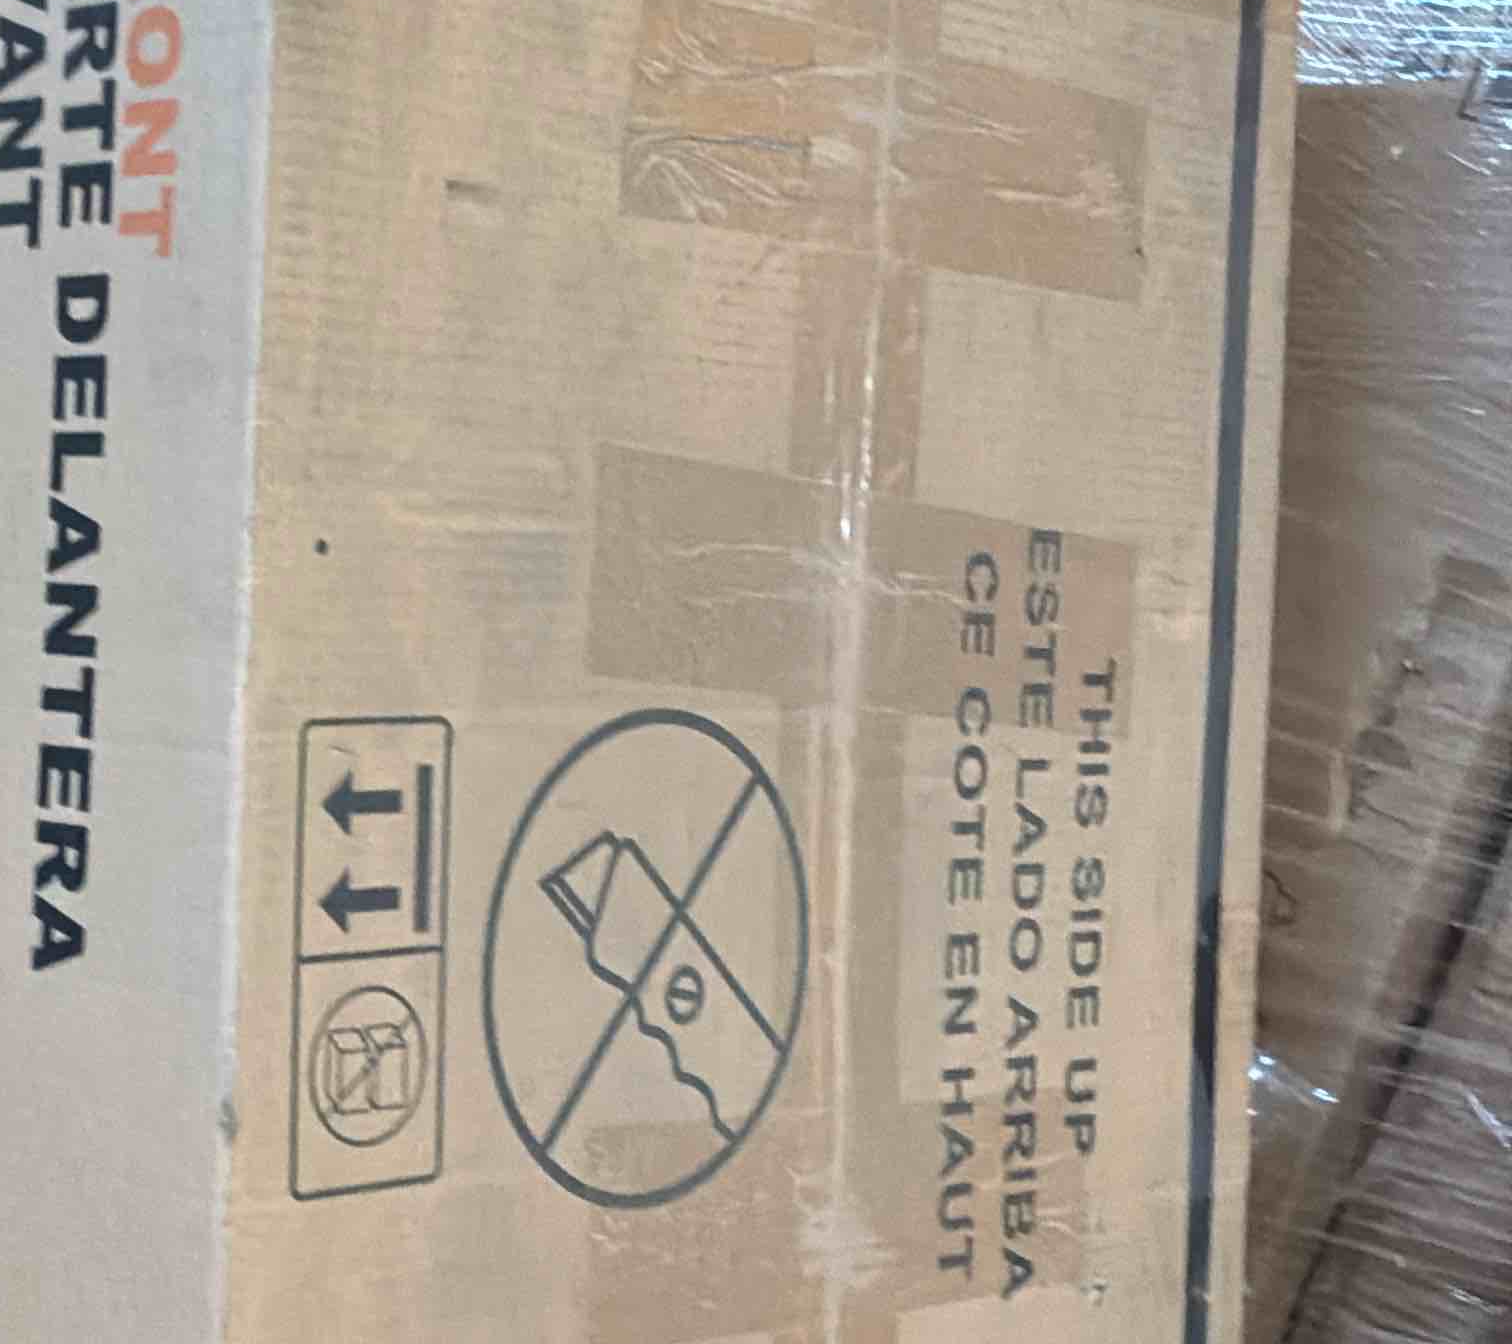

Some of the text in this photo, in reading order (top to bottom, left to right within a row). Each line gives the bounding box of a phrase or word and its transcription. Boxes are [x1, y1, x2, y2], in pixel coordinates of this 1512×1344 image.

[28, 272, 113, 973] DELANTERA
[936, 552, 999, 1282] CE COTE EN HAUT
[1000, 528, 1062, 1301] ESTE LADO ARRIBA
[1062, 659, 1117, 1156] THIS SIDE UP
